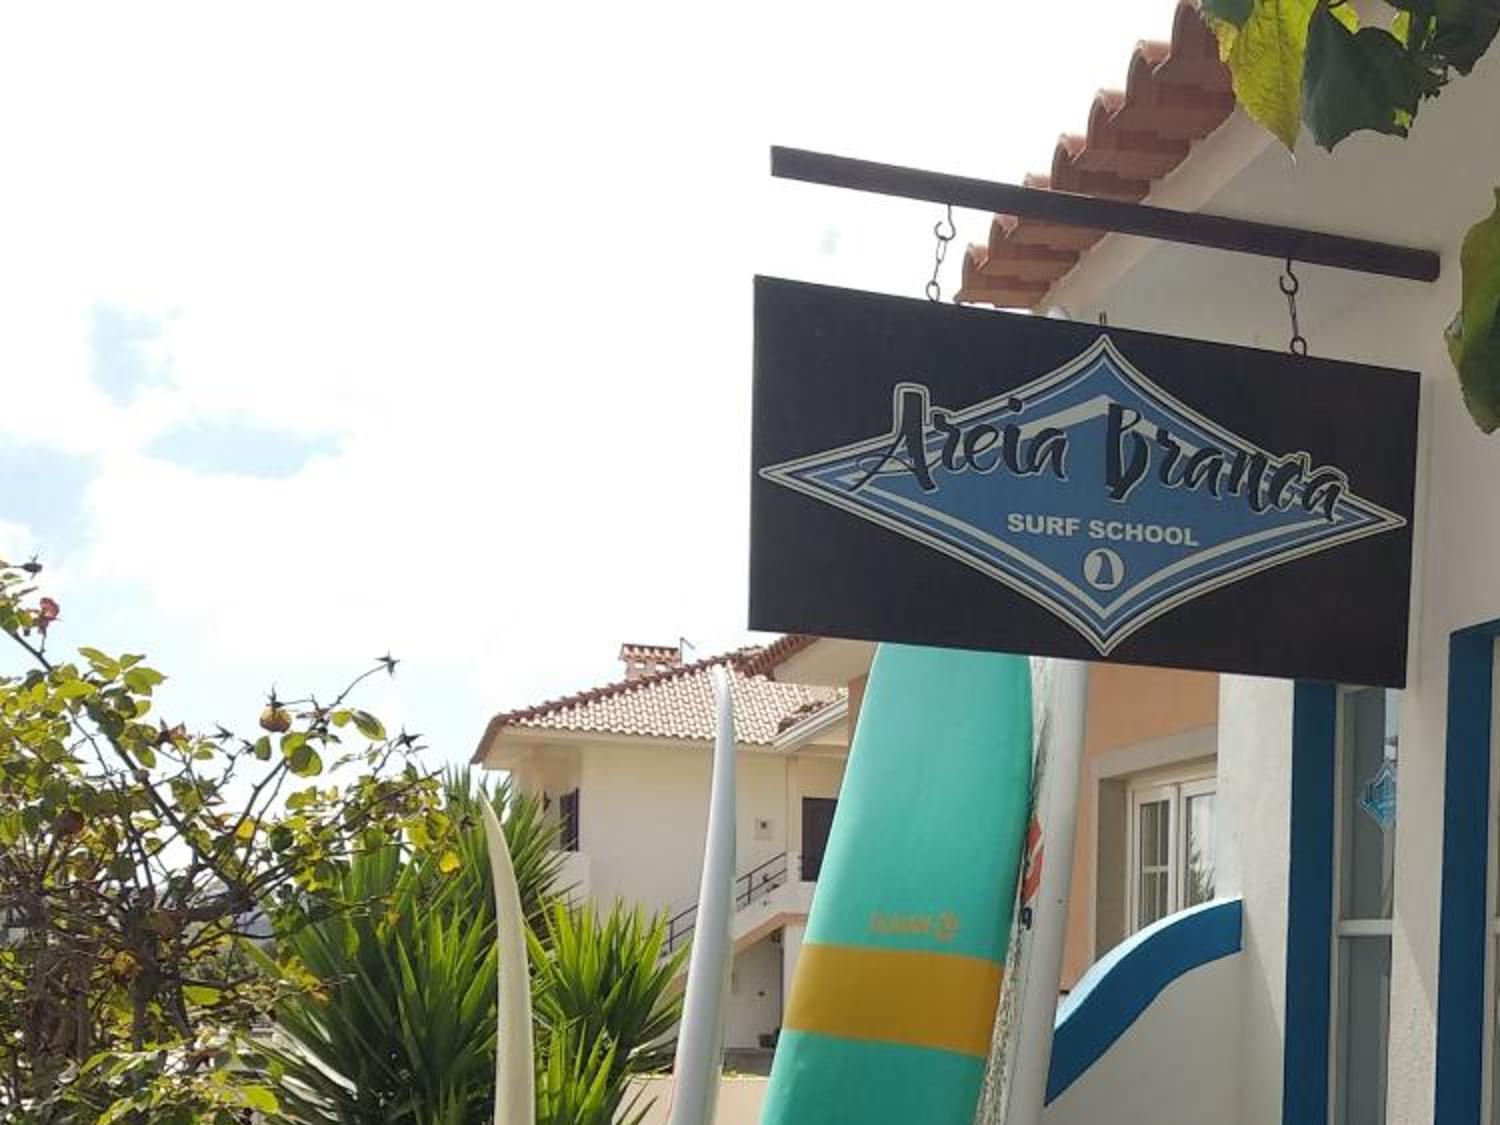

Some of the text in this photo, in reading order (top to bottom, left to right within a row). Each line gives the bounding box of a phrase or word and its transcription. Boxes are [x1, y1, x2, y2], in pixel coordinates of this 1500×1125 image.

[848, 388, 1342, 523] Areia Branca
[1007, 513, 1199, 547] SURF SCHOOL
